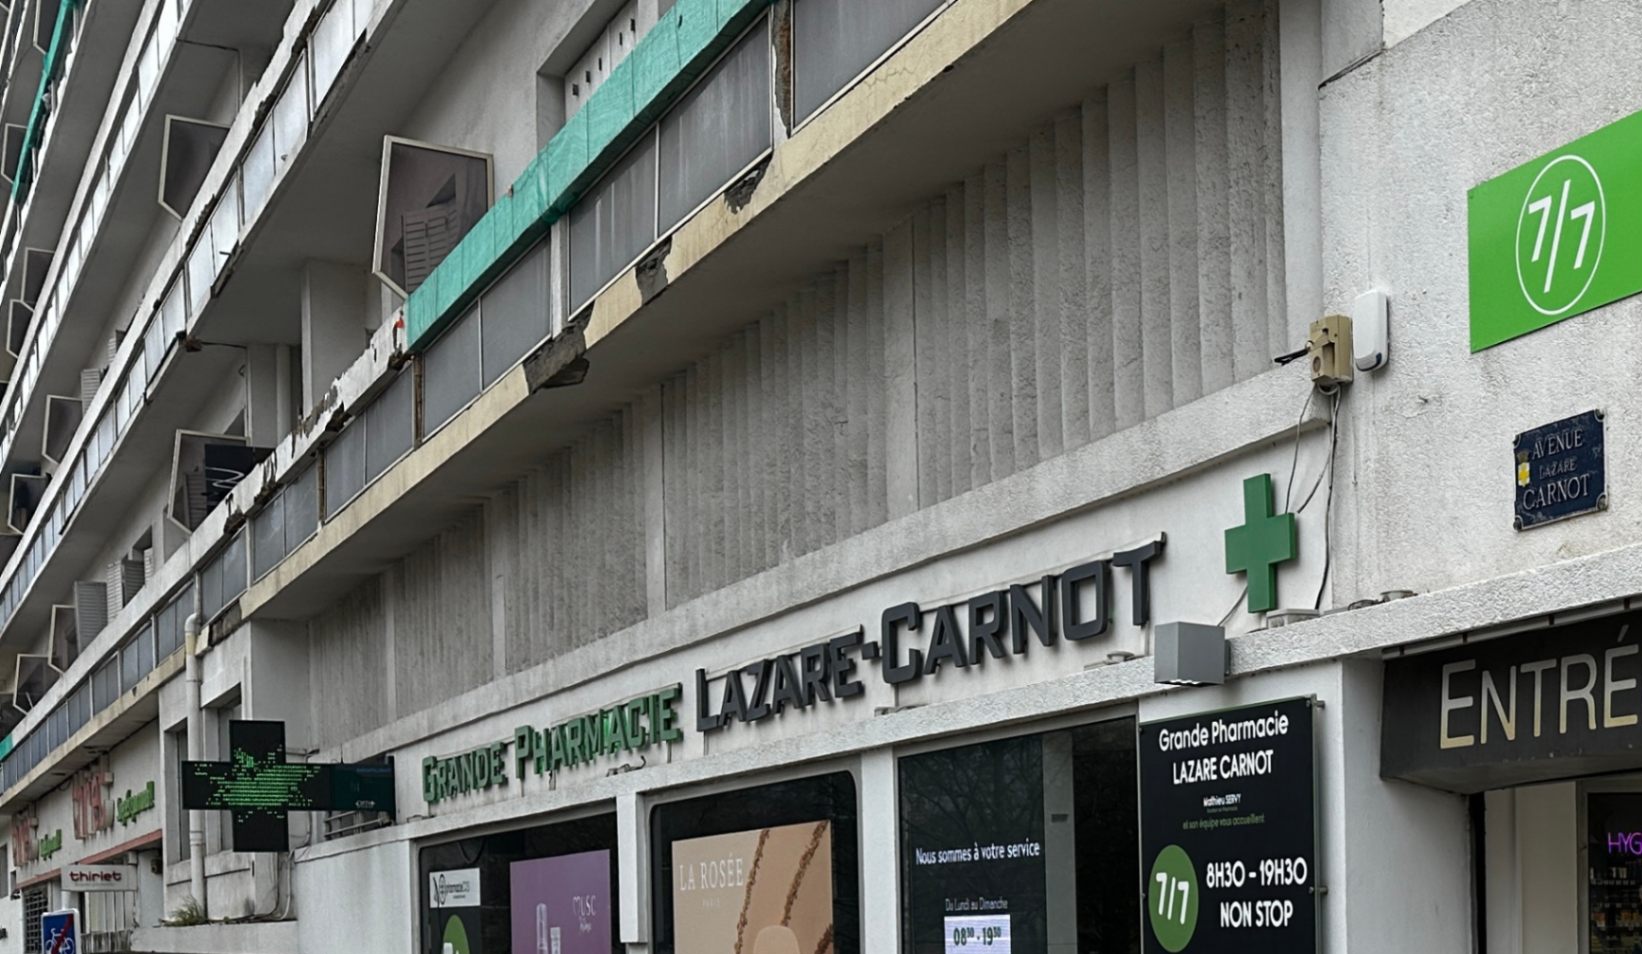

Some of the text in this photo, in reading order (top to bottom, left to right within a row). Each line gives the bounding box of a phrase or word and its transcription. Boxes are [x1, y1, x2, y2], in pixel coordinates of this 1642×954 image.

[1528, 179, 1596, 294] 7/7
[1532, 428, 1584, 459] AVENUE
[1540, 456, 1577, 479] LAZARE
[1523, 472, 1590, 510] CARNOT
[422, 684, 684, 802] GRANDE PHARMACIE
[1159, 710, 1289, 751] Grande Pharmacie
[1173, 749, 1274, 785] LAZARE CARNOT
[915, 837, 1040, 865] Nous sommes à votre service
[69, 870, 122, 883] thiriet
[680, 852, 744, 891] LA ROSÉE
[1206, 860, 1245, 888] 8H30
[1259, 857, 1308, 887] 19H30
[945, 896, 1008, 911] Du Lundi au Dimanche
[1156, 872, 1189, 925] 7/7
[1220, 899, 1294, 928] NON STOP
